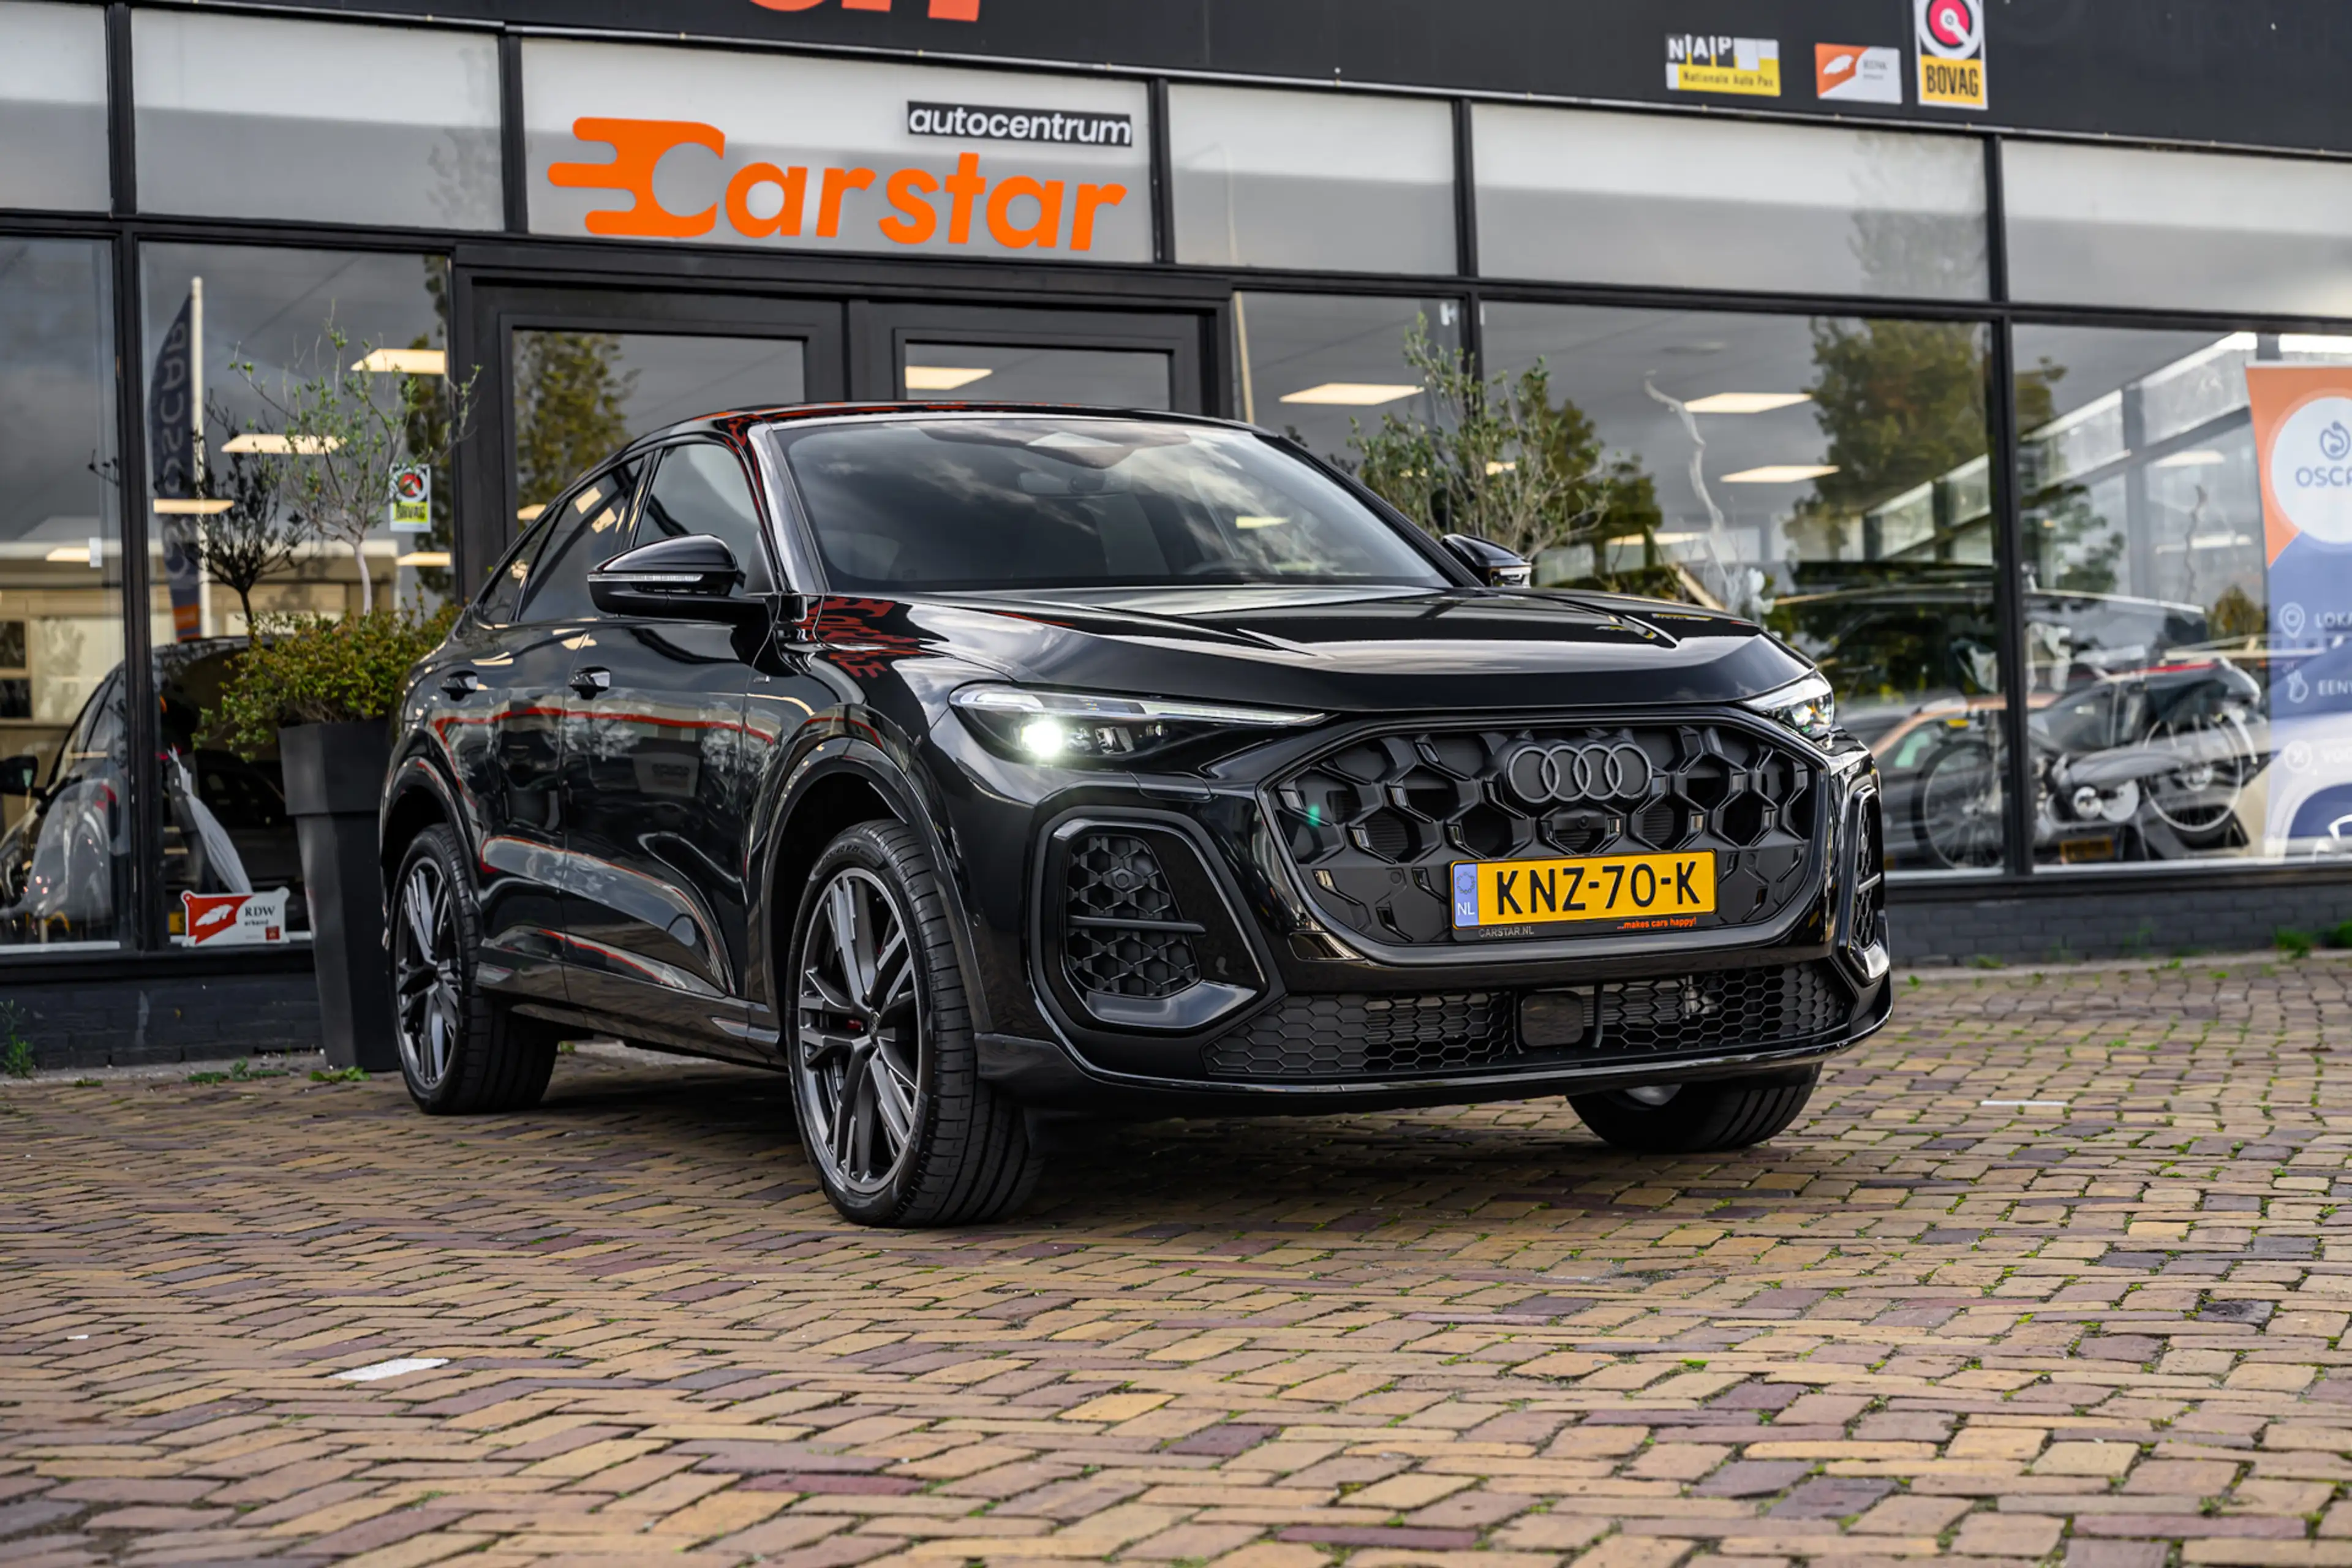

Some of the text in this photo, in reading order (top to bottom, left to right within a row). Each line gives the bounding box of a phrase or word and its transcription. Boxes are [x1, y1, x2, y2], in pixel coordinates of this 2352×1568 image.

[1926, 64, 1978, 97] BOVAG
[909, 107, 1131, 145] autocentrum
[547, 116, 1127, 252] Carstar
[1496, 861, 1701, 915] KNZ-70-K
[244, 905, 276, 917] RDW
[1457, 902, 1476, 916] NL
[1479, 926, 1535, 938] CARSTAR.NL
